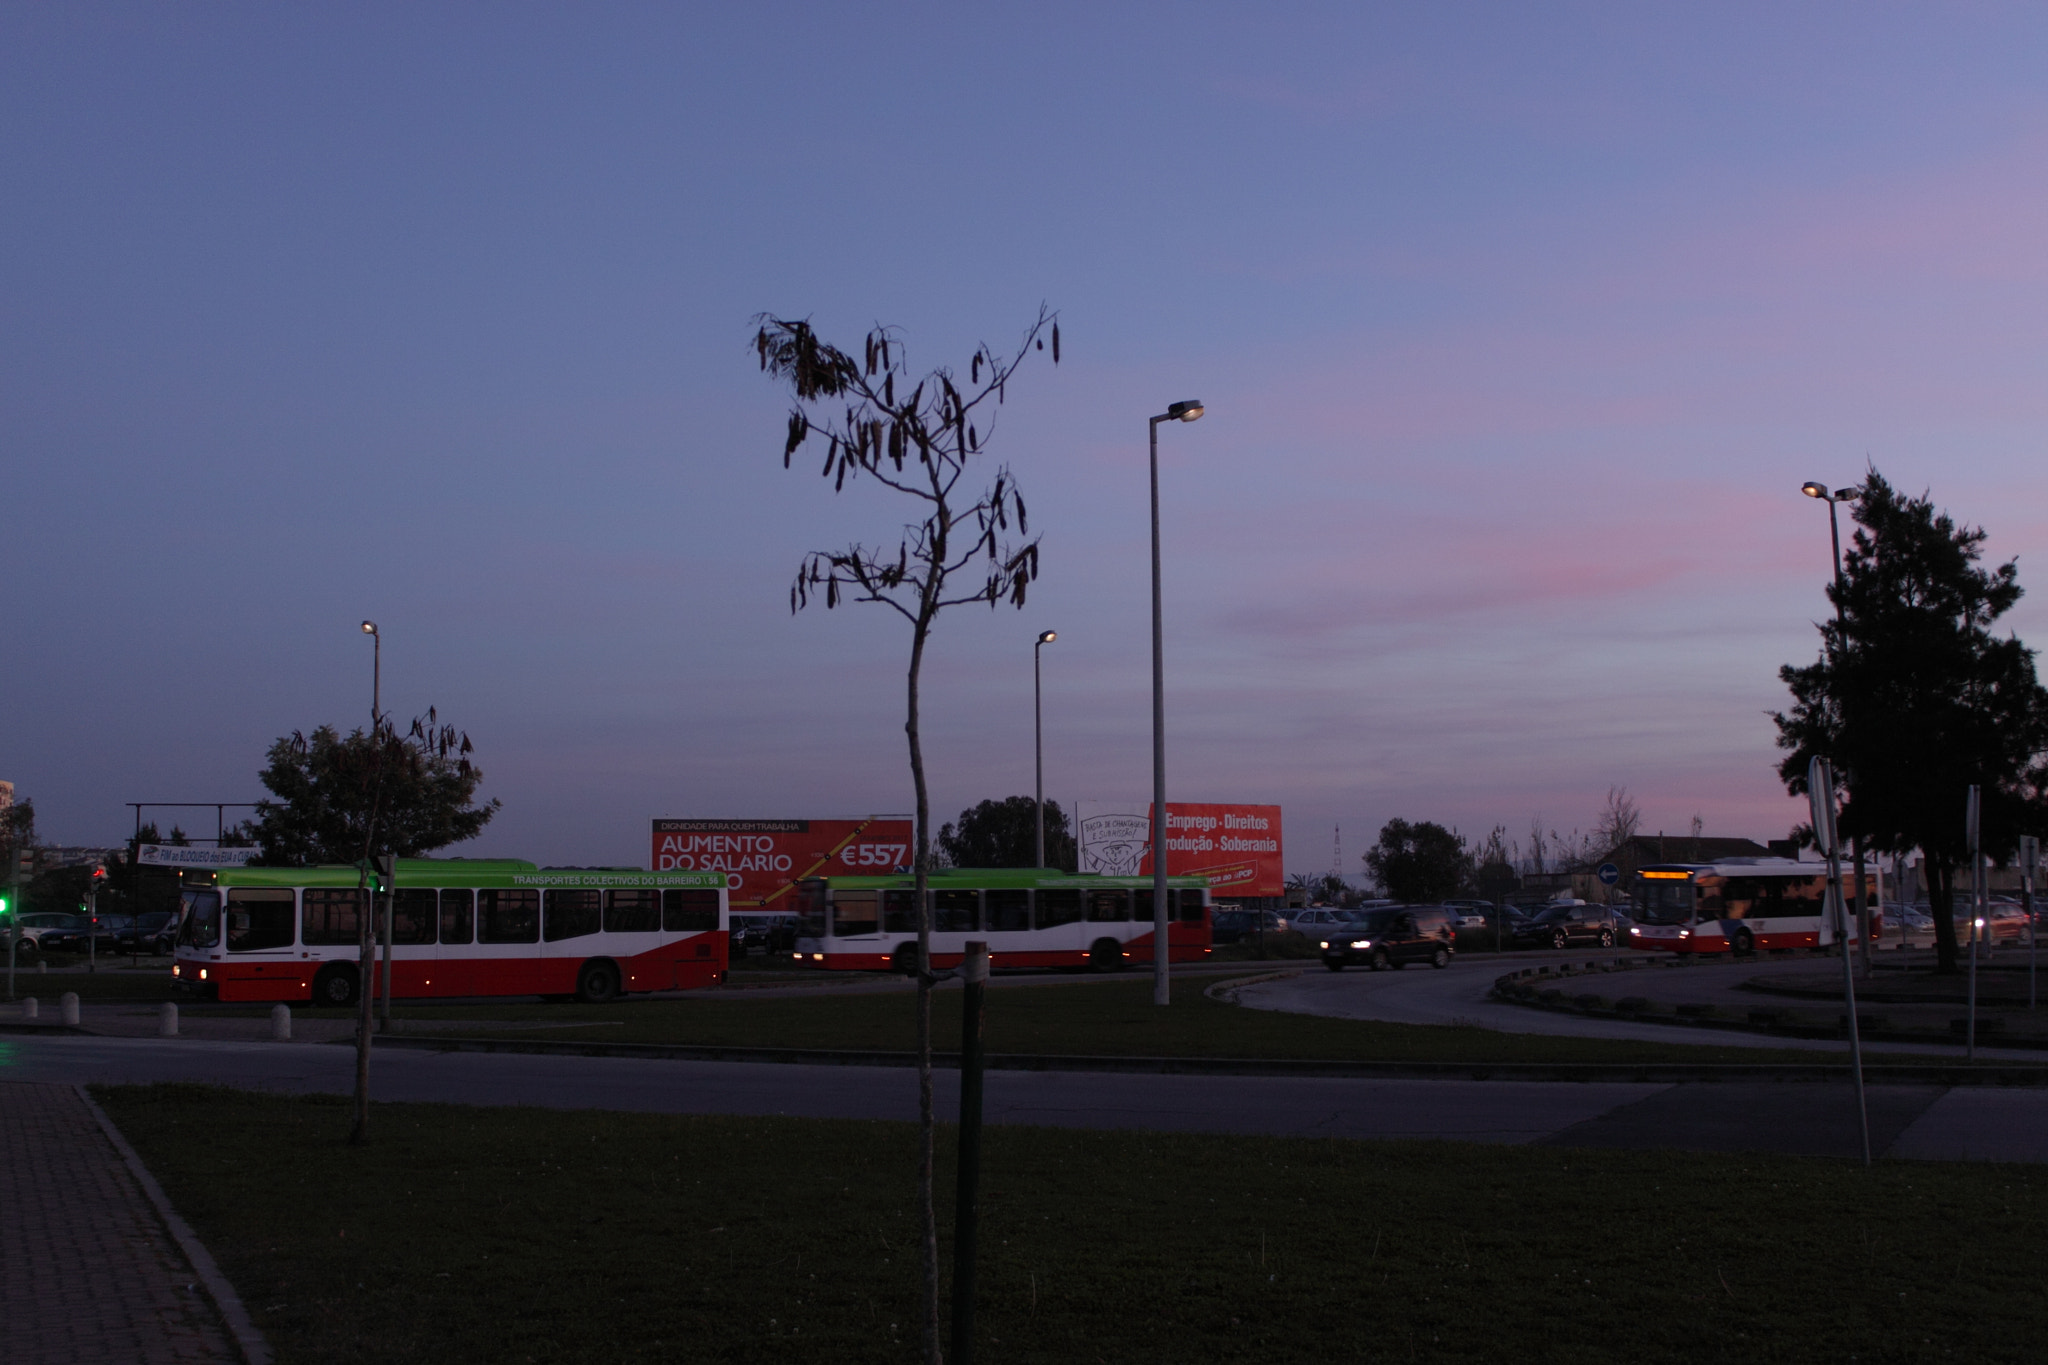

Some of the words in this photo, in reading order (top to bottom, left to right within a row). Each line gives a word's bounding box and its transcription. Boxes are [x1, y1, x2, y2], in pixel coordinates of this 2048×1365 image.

[661, 822, 708, 831] DIGNIDADE
[708, 822, 730, 831] PARA
[731, 822, 756, 831] QUEM
[756, 822, 800, 831] TRABALHA
[1085, 821, 1103, 832] BASTA
[1104, 820, 1111, 829] DE
[1112, 819, 1147, 829] CHANTAGENS
[1166, 812, 1217, 832] Emprego
[1224, 813, 1269, 830] Direitos
[1092, 832, 1098, 841] E
[660, 835, 774, 853] AUMENTO
[1165, 835, 1213, 855] rodução
[1220, 835, 1277, 852] Soberania
[160, 849, 172, 861] FIM
[179, 850, 209, 862] BLOQUEIO
[210, 852, 220, 862] dos
[220, 851, 233, 862] EUA
[840, 843, 907, 866] €557
[659, 854, 695, 871] DO
[699, 854, 793, 872] SALÁRIO
[1238, 868, 1253, 878] PCP
[513, 876, 581, 885] TRANSPORTES
[583, 876, 640, 886] COLECTIVOS
[641, 876, 655, 886] DO
[657, 876, 702, 886] BARREIRO
[708, 876, 719, 885] 56
